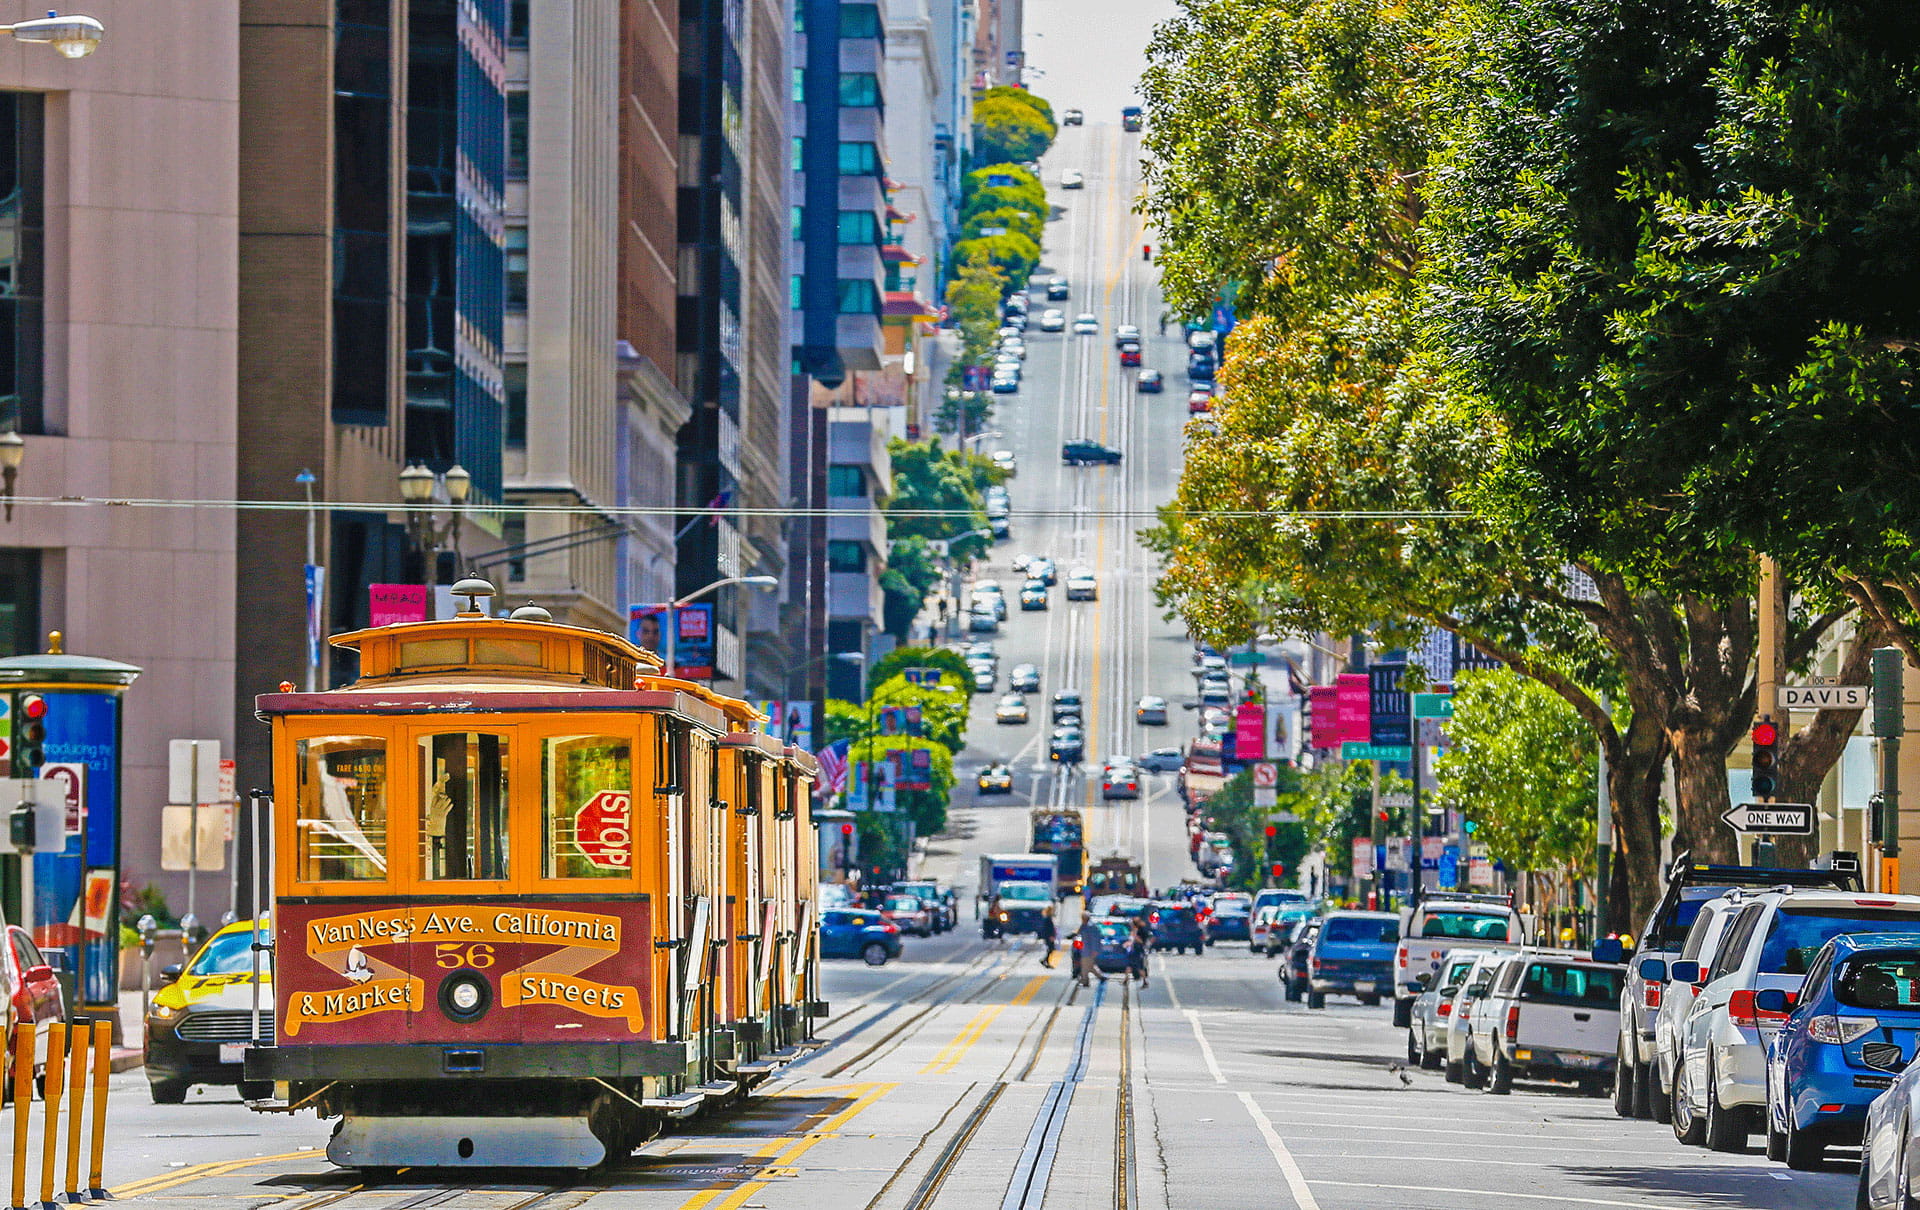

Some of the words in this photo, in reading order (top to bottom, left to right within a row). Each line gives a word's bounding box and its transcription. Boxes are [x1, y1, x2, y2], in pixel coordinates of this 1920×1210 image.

[1812, 677, 1825, 685] 100
[1786, 690, 1858, 704] DAVIS
[336, 764, 352, 773] FARE
[600, 794, 630, 865] STOP
[1747, 812, 1771, 825] ONE
[1776, 813, 1801, 825] WAY
[312, 922, 356, 945] Van
[357, 916, 416, 939] Ness
[494, 912, 617, 942] California
[435, 942, 496, 969] 56
[301, 994, 319, 1016] &
[323, 982, 412, 1016] Market
[522, 977, 625, 1010] Streets
